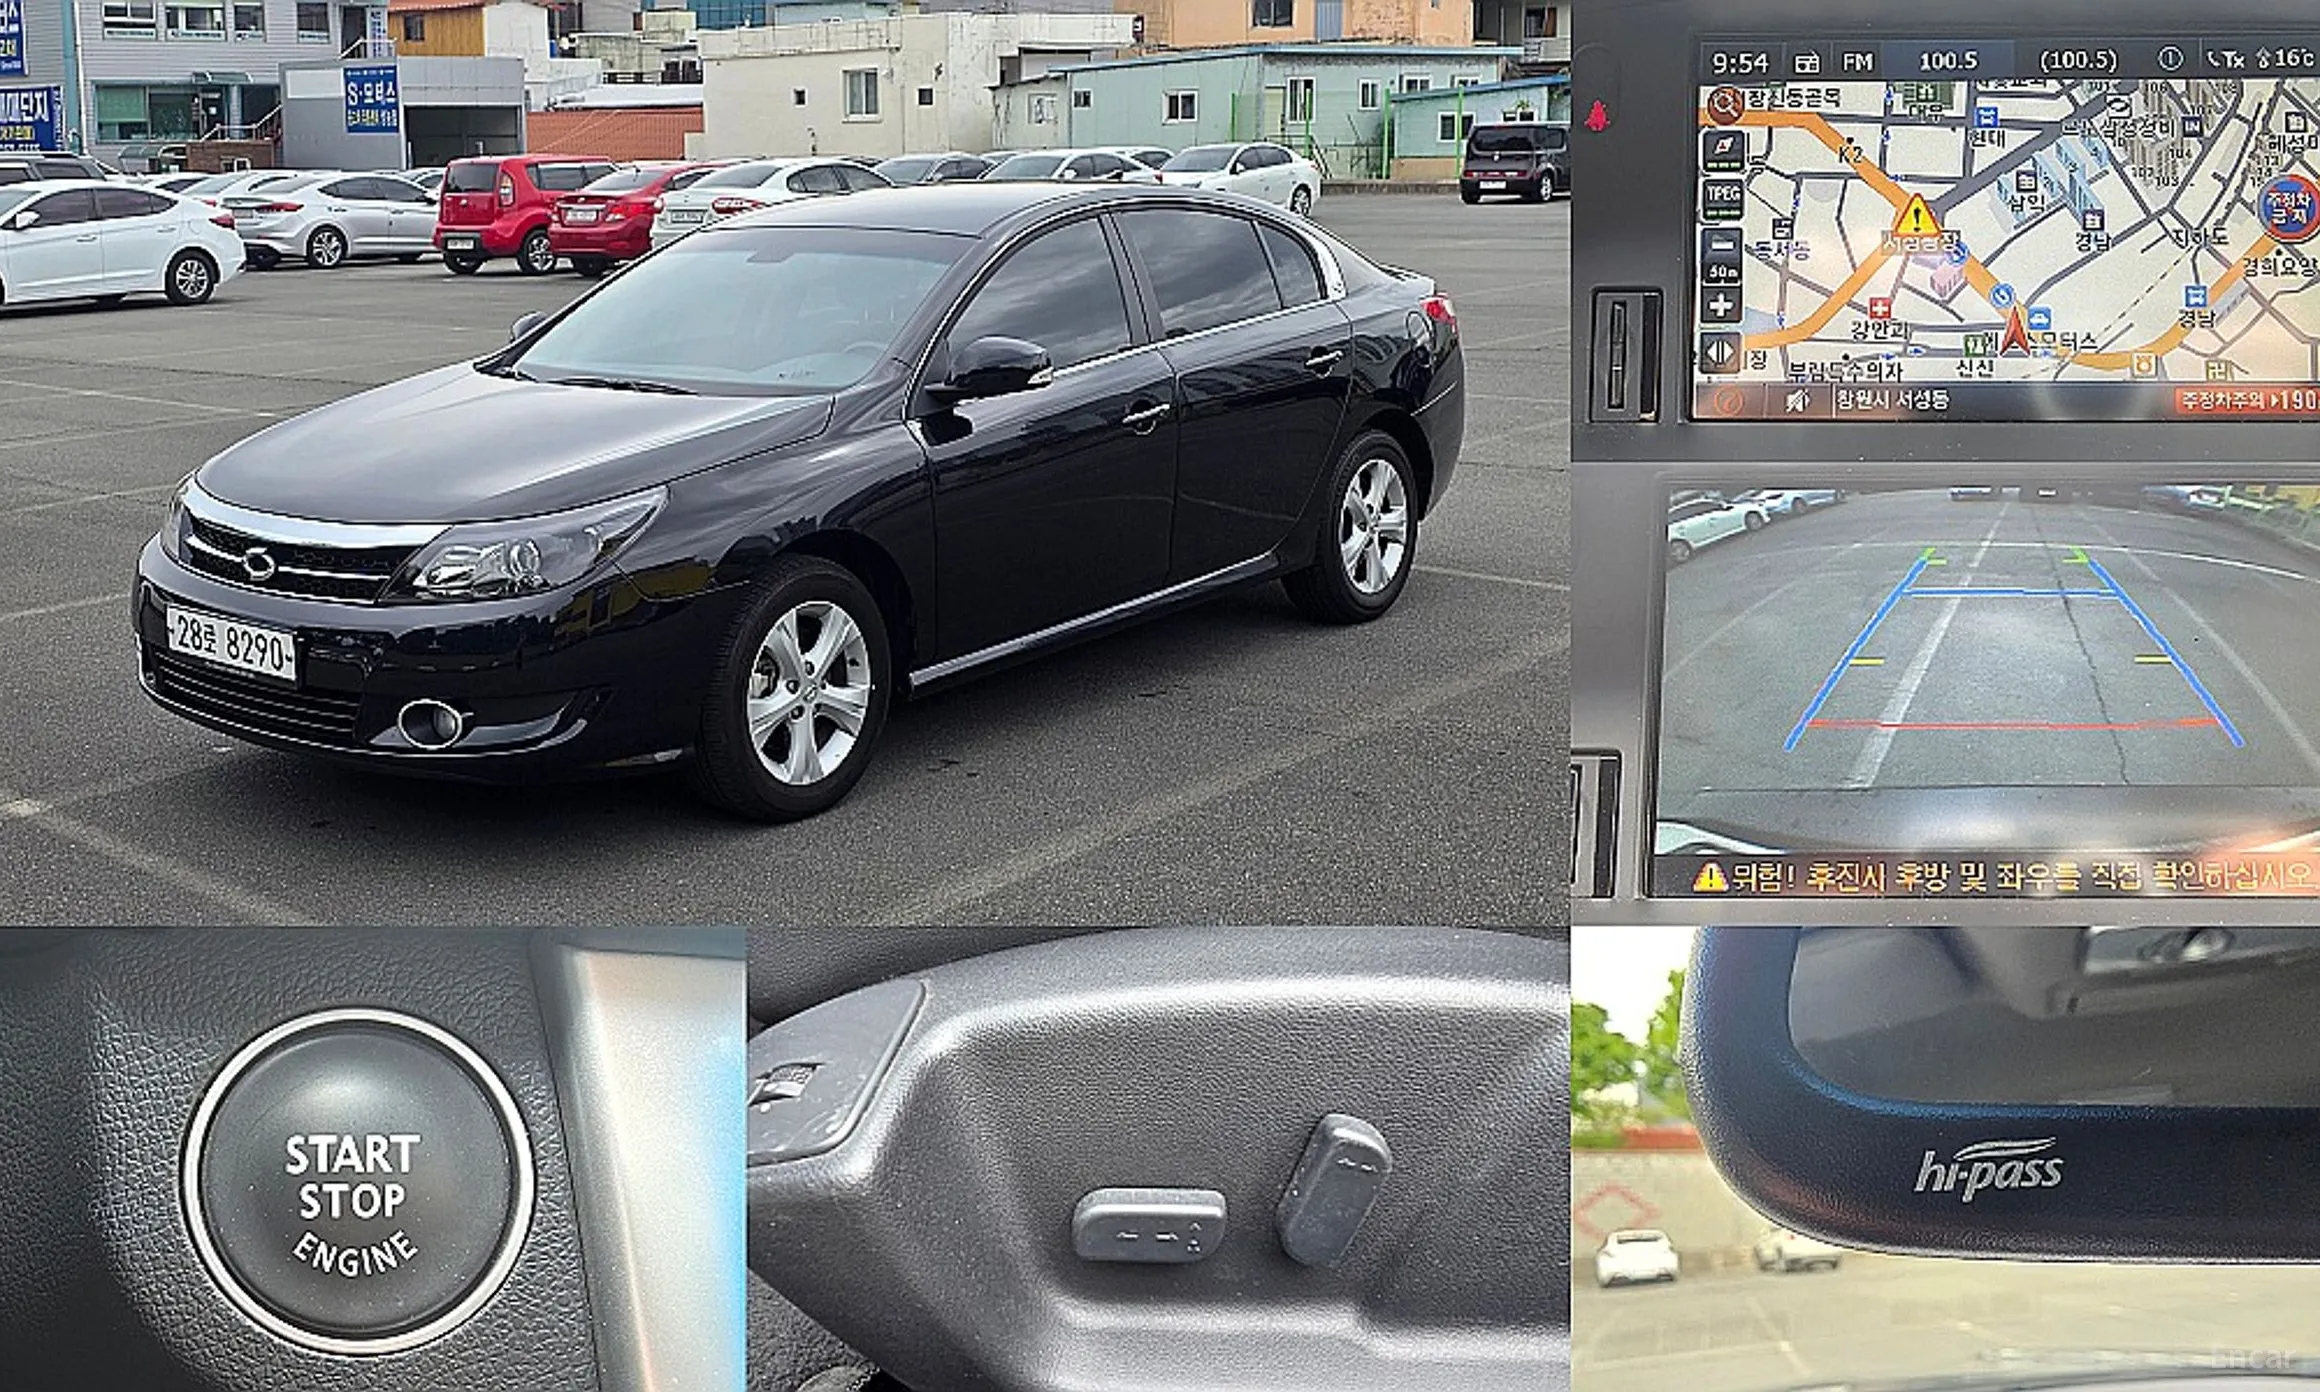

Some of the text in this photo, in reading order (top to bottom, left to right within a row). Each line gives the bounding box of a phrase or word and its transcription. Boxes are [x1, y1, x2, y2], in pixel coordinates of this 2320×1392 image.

[1713, 53, 1769, 73] 9:54
[1843, 53, 1873, 71] FM
[1920, 52, 1978, 70] 100.5
[2041, 50, 2117, 72] (100.5)
[1970, 129, 2006, 148] 현대
[1707, 186, 1740, 201] TPEG
[2076, 233, 2112, 252] 경남
[1709, 267, 1738, 278] 50m
[2179, 309, 2216, 328] 경남
[1838, 389, 1950, 410] 창원시 서성동
[226, 626, 284, 671] 8290
[1733, 861, 2320, 892] 위험! 후진시 후방 및 좌우를 직접 확인하십시오
[285, 1133, 422, 1176] START
[1913, 1150, 2064, 1203] hi-pass
[299, 1182, 405, 1220] STOP
[291, 1229, 419, 1278] ENGINE
